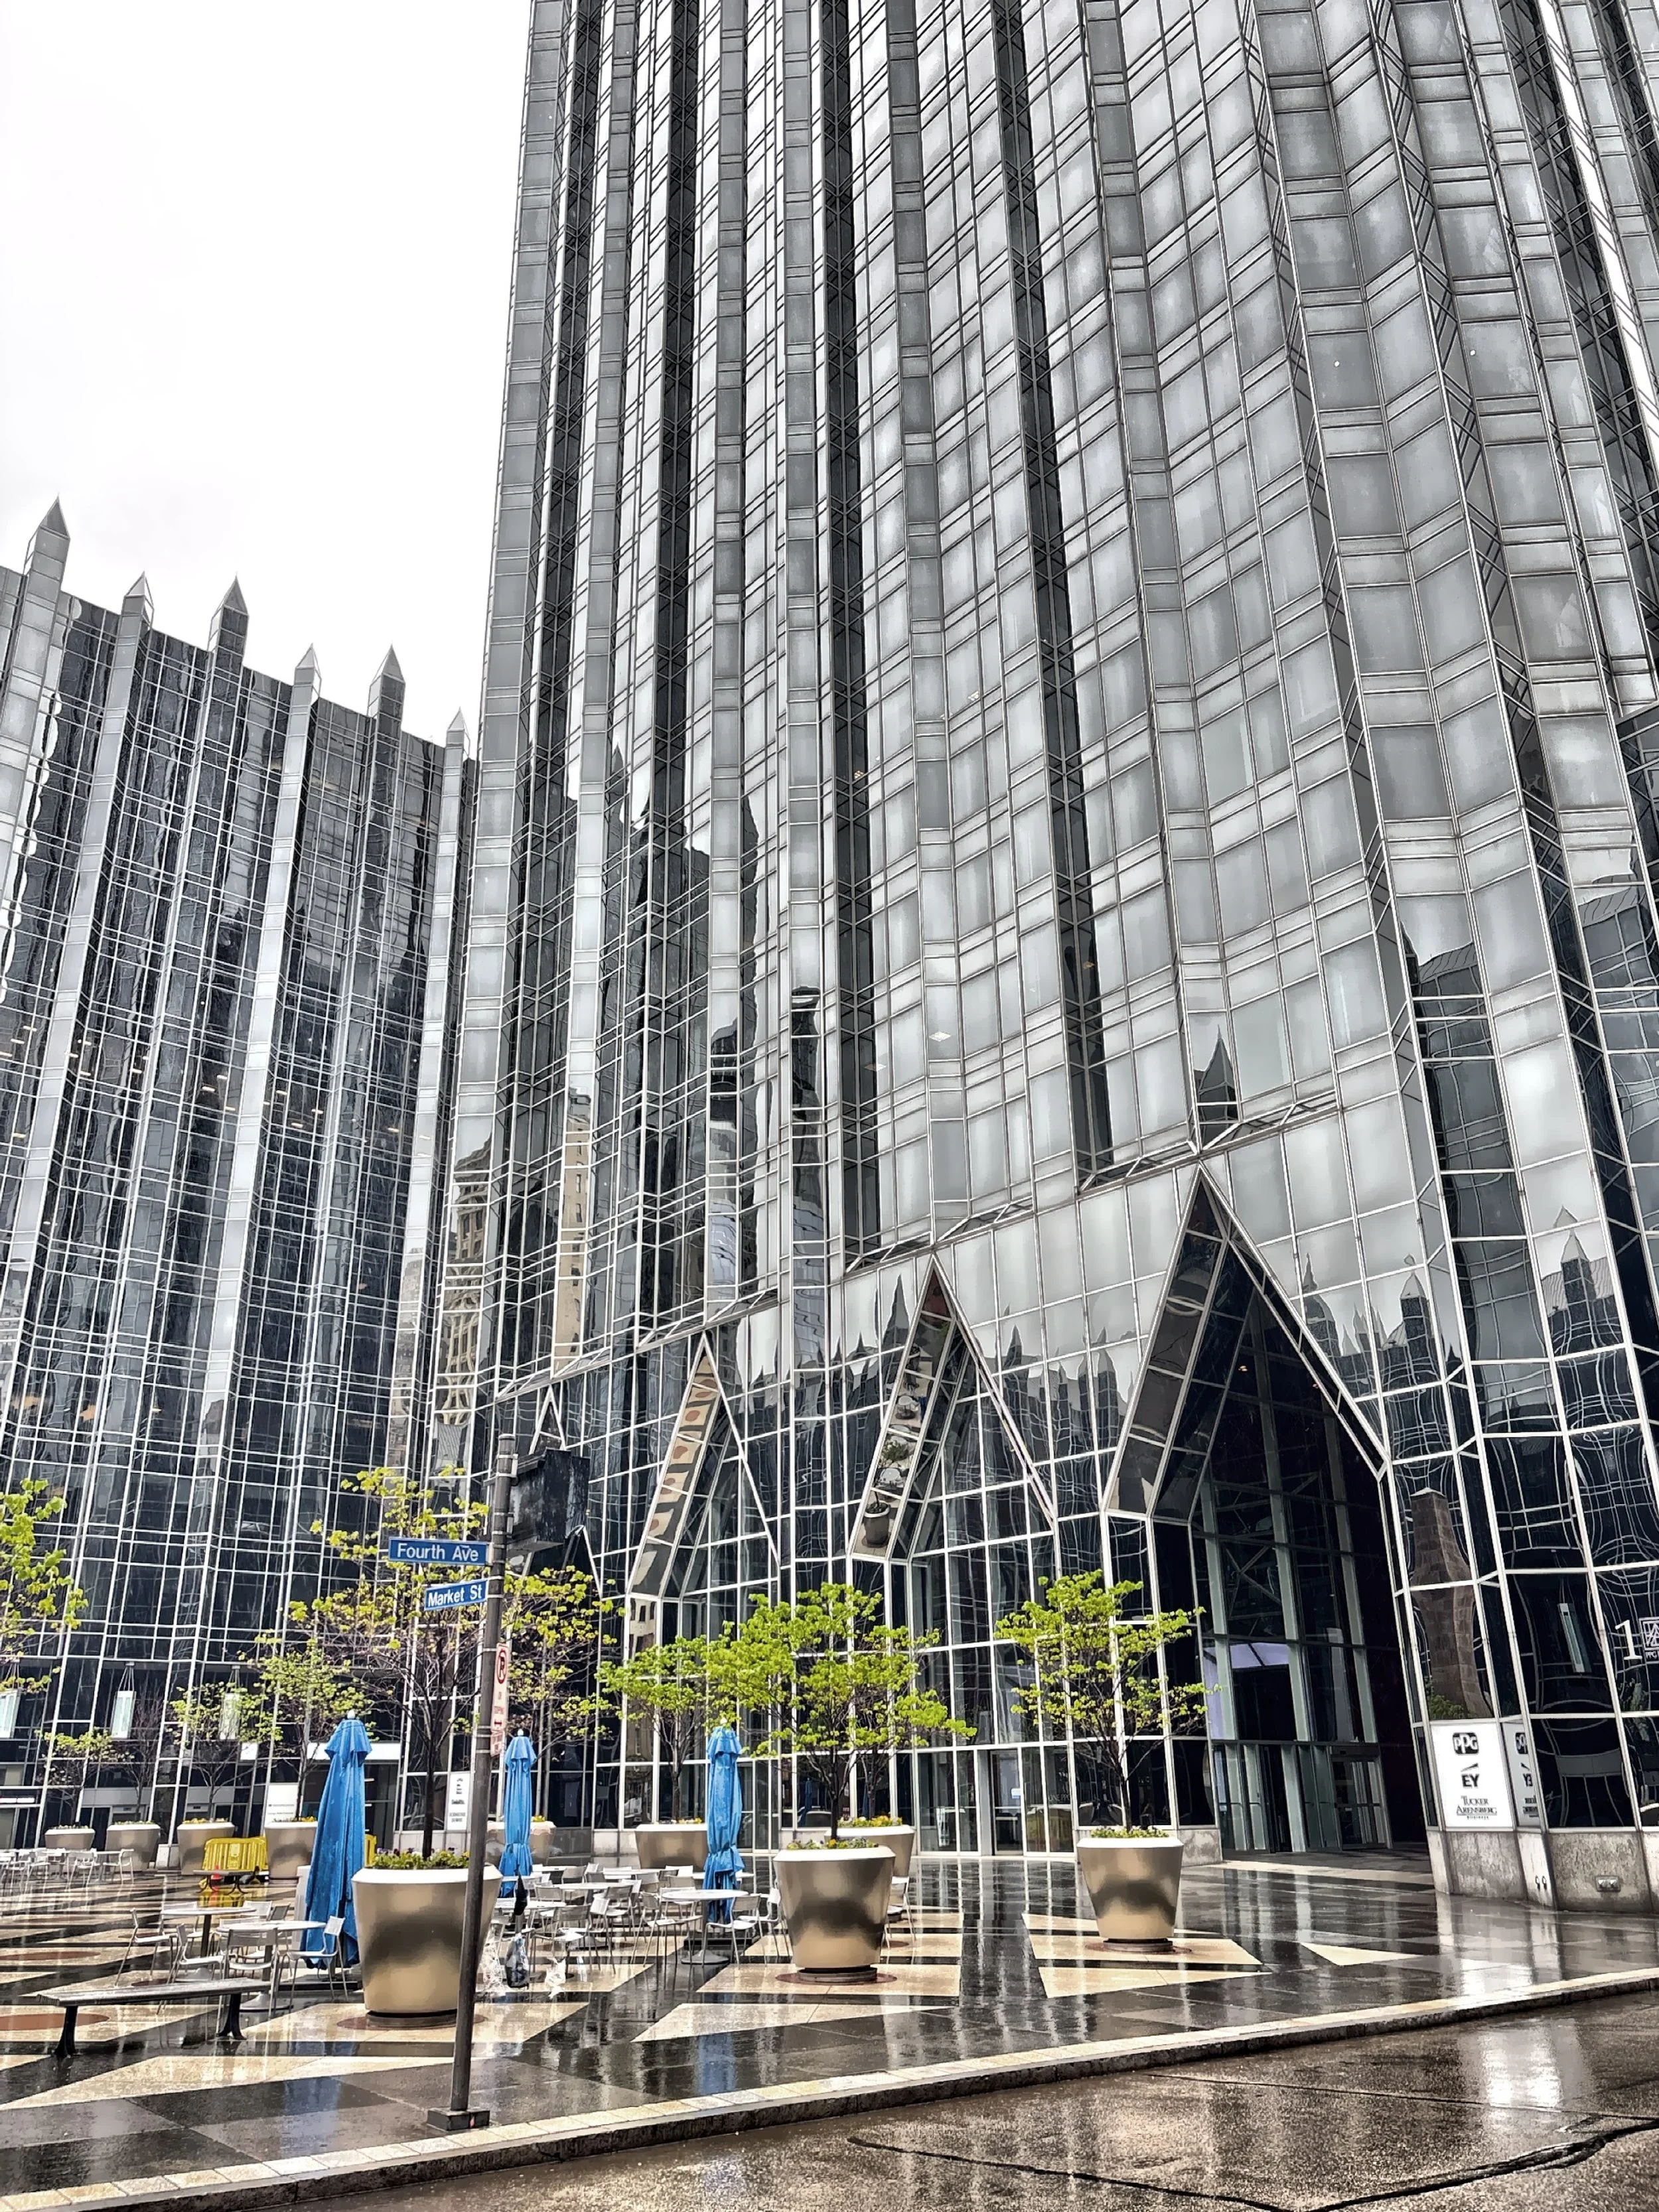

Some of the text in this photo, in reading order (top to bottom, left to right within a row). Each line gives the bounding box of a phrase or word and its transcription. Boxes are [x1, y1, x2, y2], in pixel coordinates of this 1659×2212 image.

[397, 1543, 479, 1562] Fourth Ave
[428, 1584, 482, 1607] Market St
[1615, 1620, 1642, 1660] 1
[1453, 1733, 1479, 1754] PPG
[1461, 1773, 1480, 1788] EY
[1461, 1795, 1489, 1805] TUCKER
